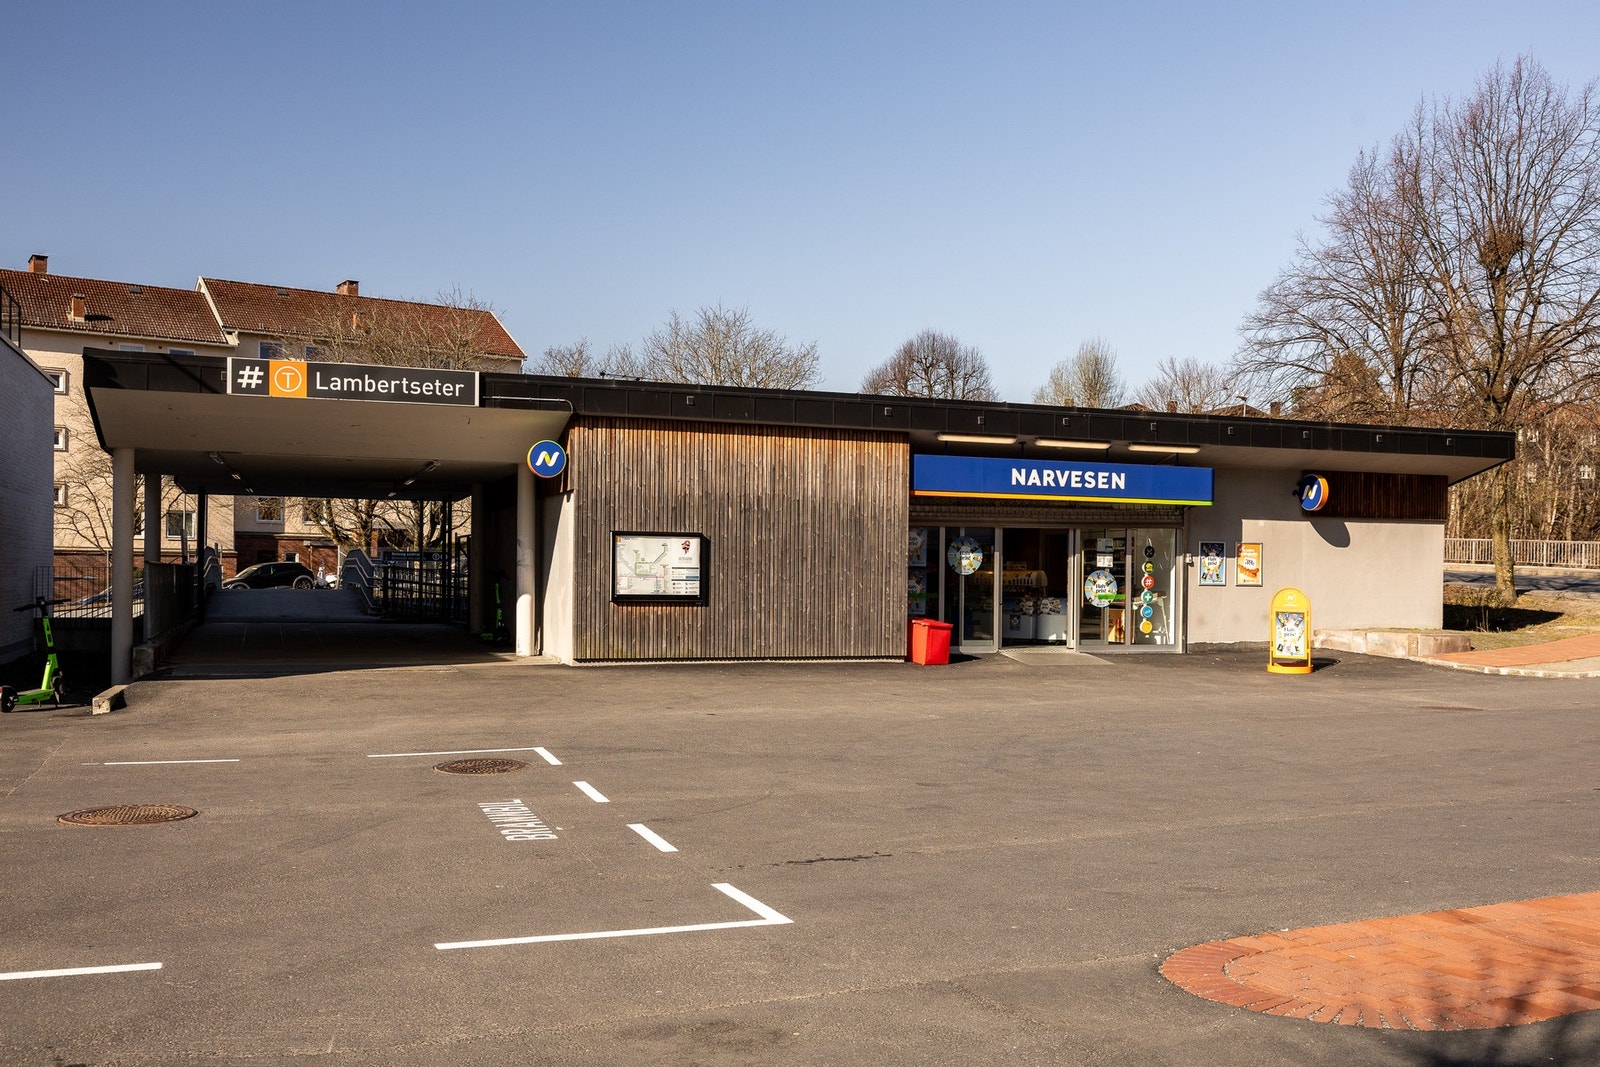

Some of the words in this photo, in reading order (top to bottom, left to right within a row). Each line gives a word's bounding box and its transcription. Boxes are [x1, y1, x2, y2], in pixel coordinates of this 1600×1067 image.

[316, 371, 465, 397] Lambertseter
[1011, 467, 1126, 490] NARVESEN
[477, 799, 559, 841] BRANNBIL
